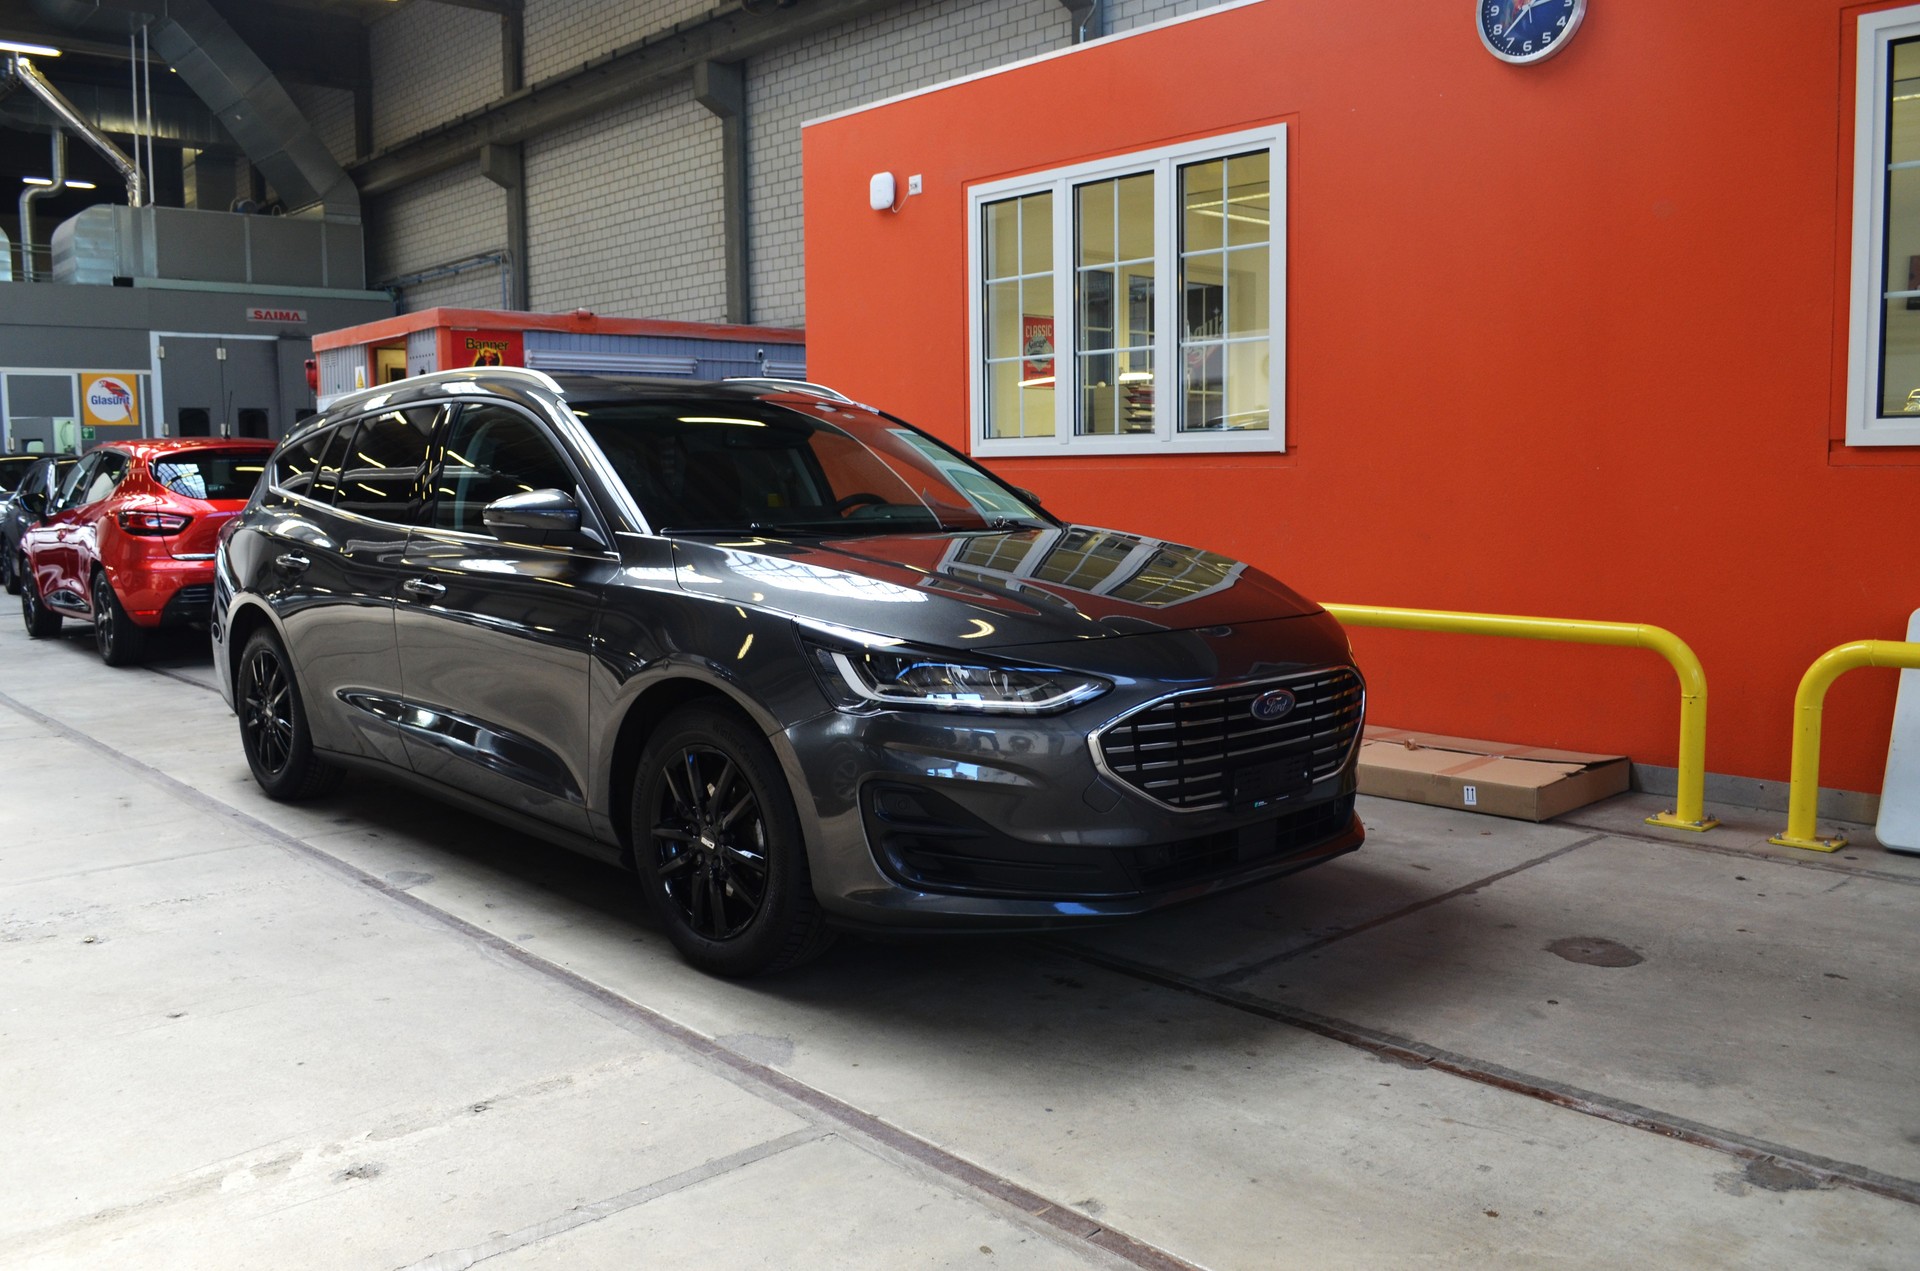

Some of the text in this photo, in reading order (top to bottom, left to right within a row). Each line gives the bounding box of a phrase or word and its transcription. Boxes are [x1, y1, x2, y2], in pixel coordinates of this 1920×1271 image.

[1490, 5, 1500, 17] 9
[1556, 16, 1566, 27] 4
[1493, 24, 1503, 36] 8
[1506, 37, 1515, 49] 7
[1541, 32, 1552, 43] 5
[1522, 40, 1532, 52] 6
[253, 309, 303, 322] SAIMA
[1025, 324, 1053, 338] CLASSIC
[465, 337, 510, 351] Banner
[91, 394, 130, 405] Glasurit
[1263, 696, 1289, 715] Ford
